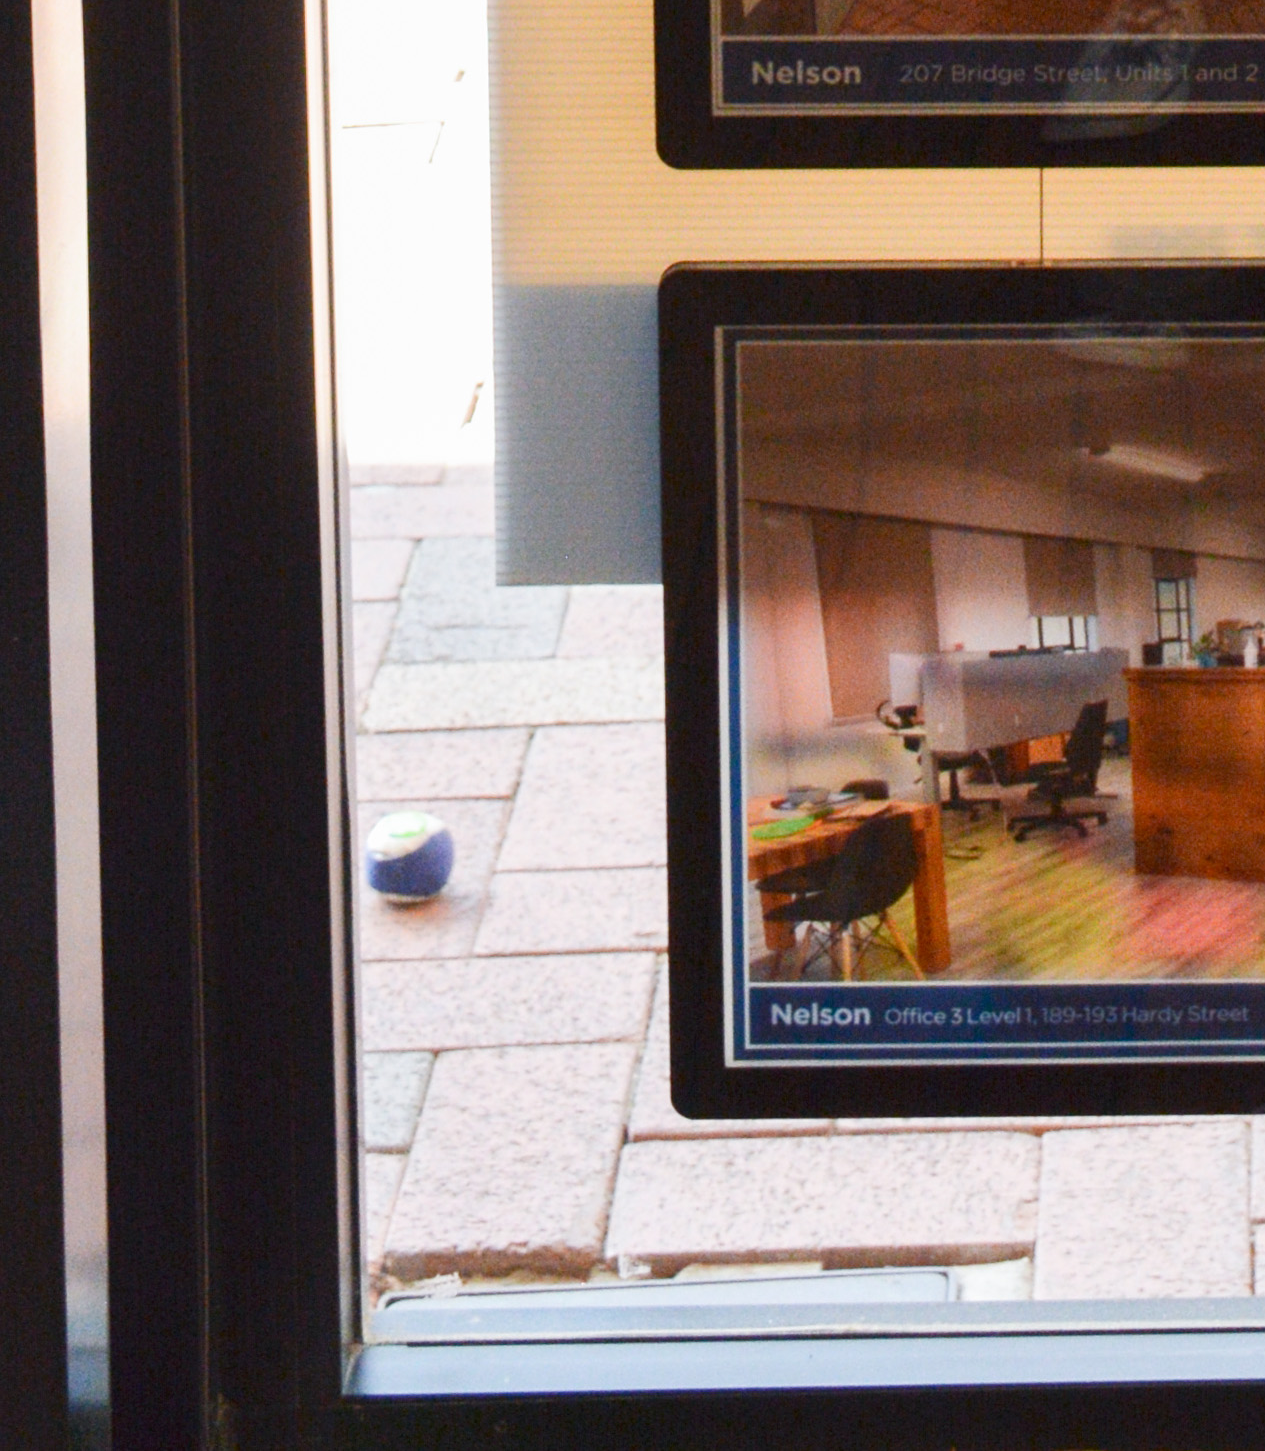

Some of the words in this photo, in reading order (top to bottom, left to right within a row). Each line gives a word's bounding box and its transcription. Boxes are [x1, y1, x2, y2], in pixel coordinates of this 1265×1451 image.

[751, 58, 863, 86] Nelson
[900, 63, 943, 84] 207
[950, 62, 1027, 87] Bridge
[1115, 62, 1174, 83] Units
[1178, 63, 1188, 83] 1
[1195, 63, 1238, 83] and
[1245, 63, 1259, 83] 2
[770, 1002, 871, 1026] Nelson
[884, 1005, 947, 1026] Office
[951, 1007, 963, 1025] 3
[966, 1006, 1021, 1025] Level
[1025, 1007, 1038, 1027] 1,
[1042, 1006, 1118, 1024] 189-193
[1122, 1005, 1183, 1026] Hardy
[1187, 1004, 1250, 1023] Street
